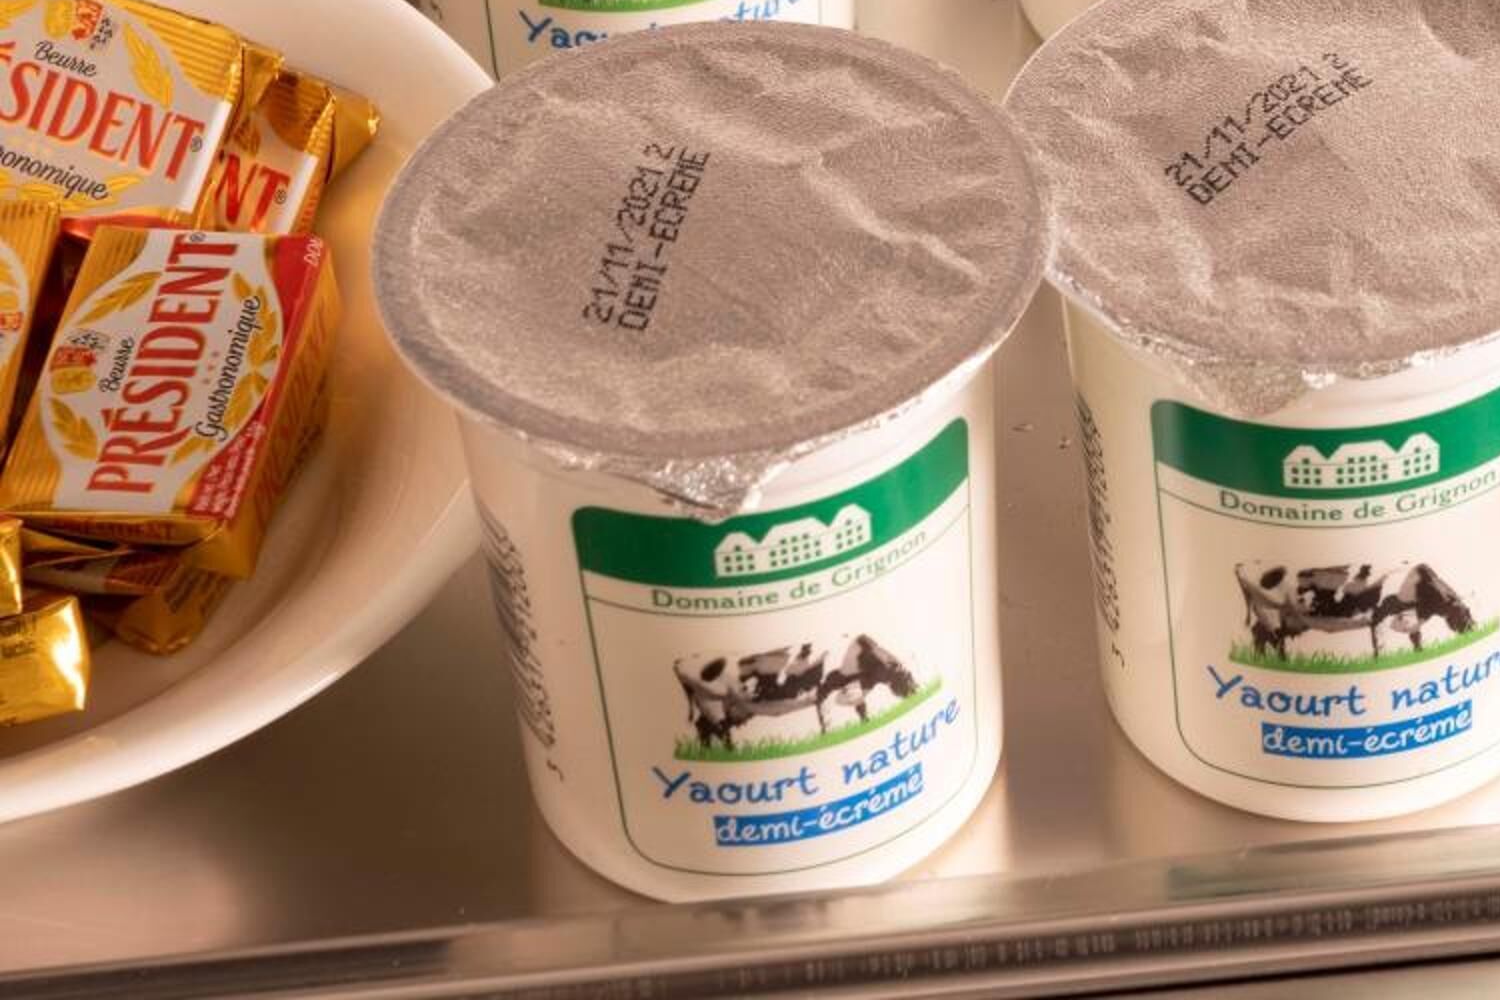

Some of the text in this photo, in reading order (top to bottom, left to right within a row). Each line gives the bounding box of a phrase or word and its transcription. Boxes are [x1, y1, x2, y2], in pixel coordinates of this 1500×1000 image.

[35, 39, 97, 77] Beurre
[0, 58, 206, 182] SIDENT
[1164, 66, 1321, 187] 21/11/2021
[583, 143, 675, 323] 21/11/2021 2
[86, 233, 242, 494] PRÉSIDENT
[101, 336, 137, 395] Beurre
[194, 295, 263, 443] Gastronomique
[1219, 468, 1497, 521] Domaine de Grignon
[651, 530, 927, 610] Domaine de Grignon
[1207, 664, 1366, 717] Yaourt
[1263, 703, 1473, 754] demi-écrémé
[652, 697, 962, 804] Yaourt nature
[715, 765, 924, 843] demi-écrémé
